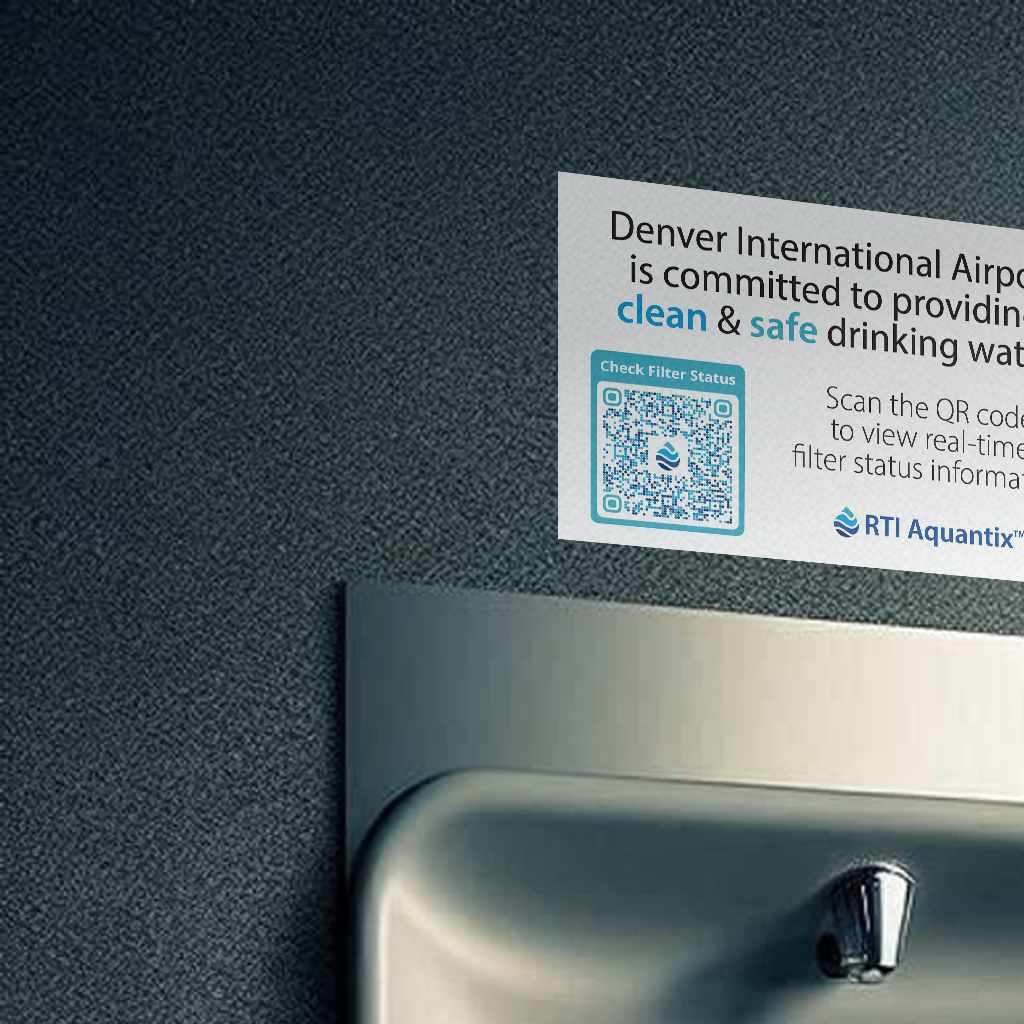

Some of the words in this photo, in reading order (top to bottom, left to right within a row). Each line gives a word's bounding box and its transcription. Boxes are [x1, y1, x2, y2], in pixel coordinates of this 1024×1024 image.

[612, 211, 727, 252] Denver
[739, 226, 940, 278] International
[631, 254, 653, 284] is
[664, 266, 840, 306] committed
[851, 283, 882, 311] to
[618, 294, 706, 331] clean
[718, 305, 740, 335] &
[751, 312, 817, 343] safe
[827, 322, 957, 367] drinking
[601, 361, 644, 375] Check
[649, 366, 686, 379] Filter
[691, 370, 735, 385] Status
[827, 386, 881, 414] Scan
[890, 393, 928, 419] the
[937, 398, 969, 424] QR
[831, 419, 853, 441] to
[862, 423, 917, 448] view
[792, 443, 846, 471] filter
[854, 454, 922, 479] status
[866, 515, 899, 537] RTI
